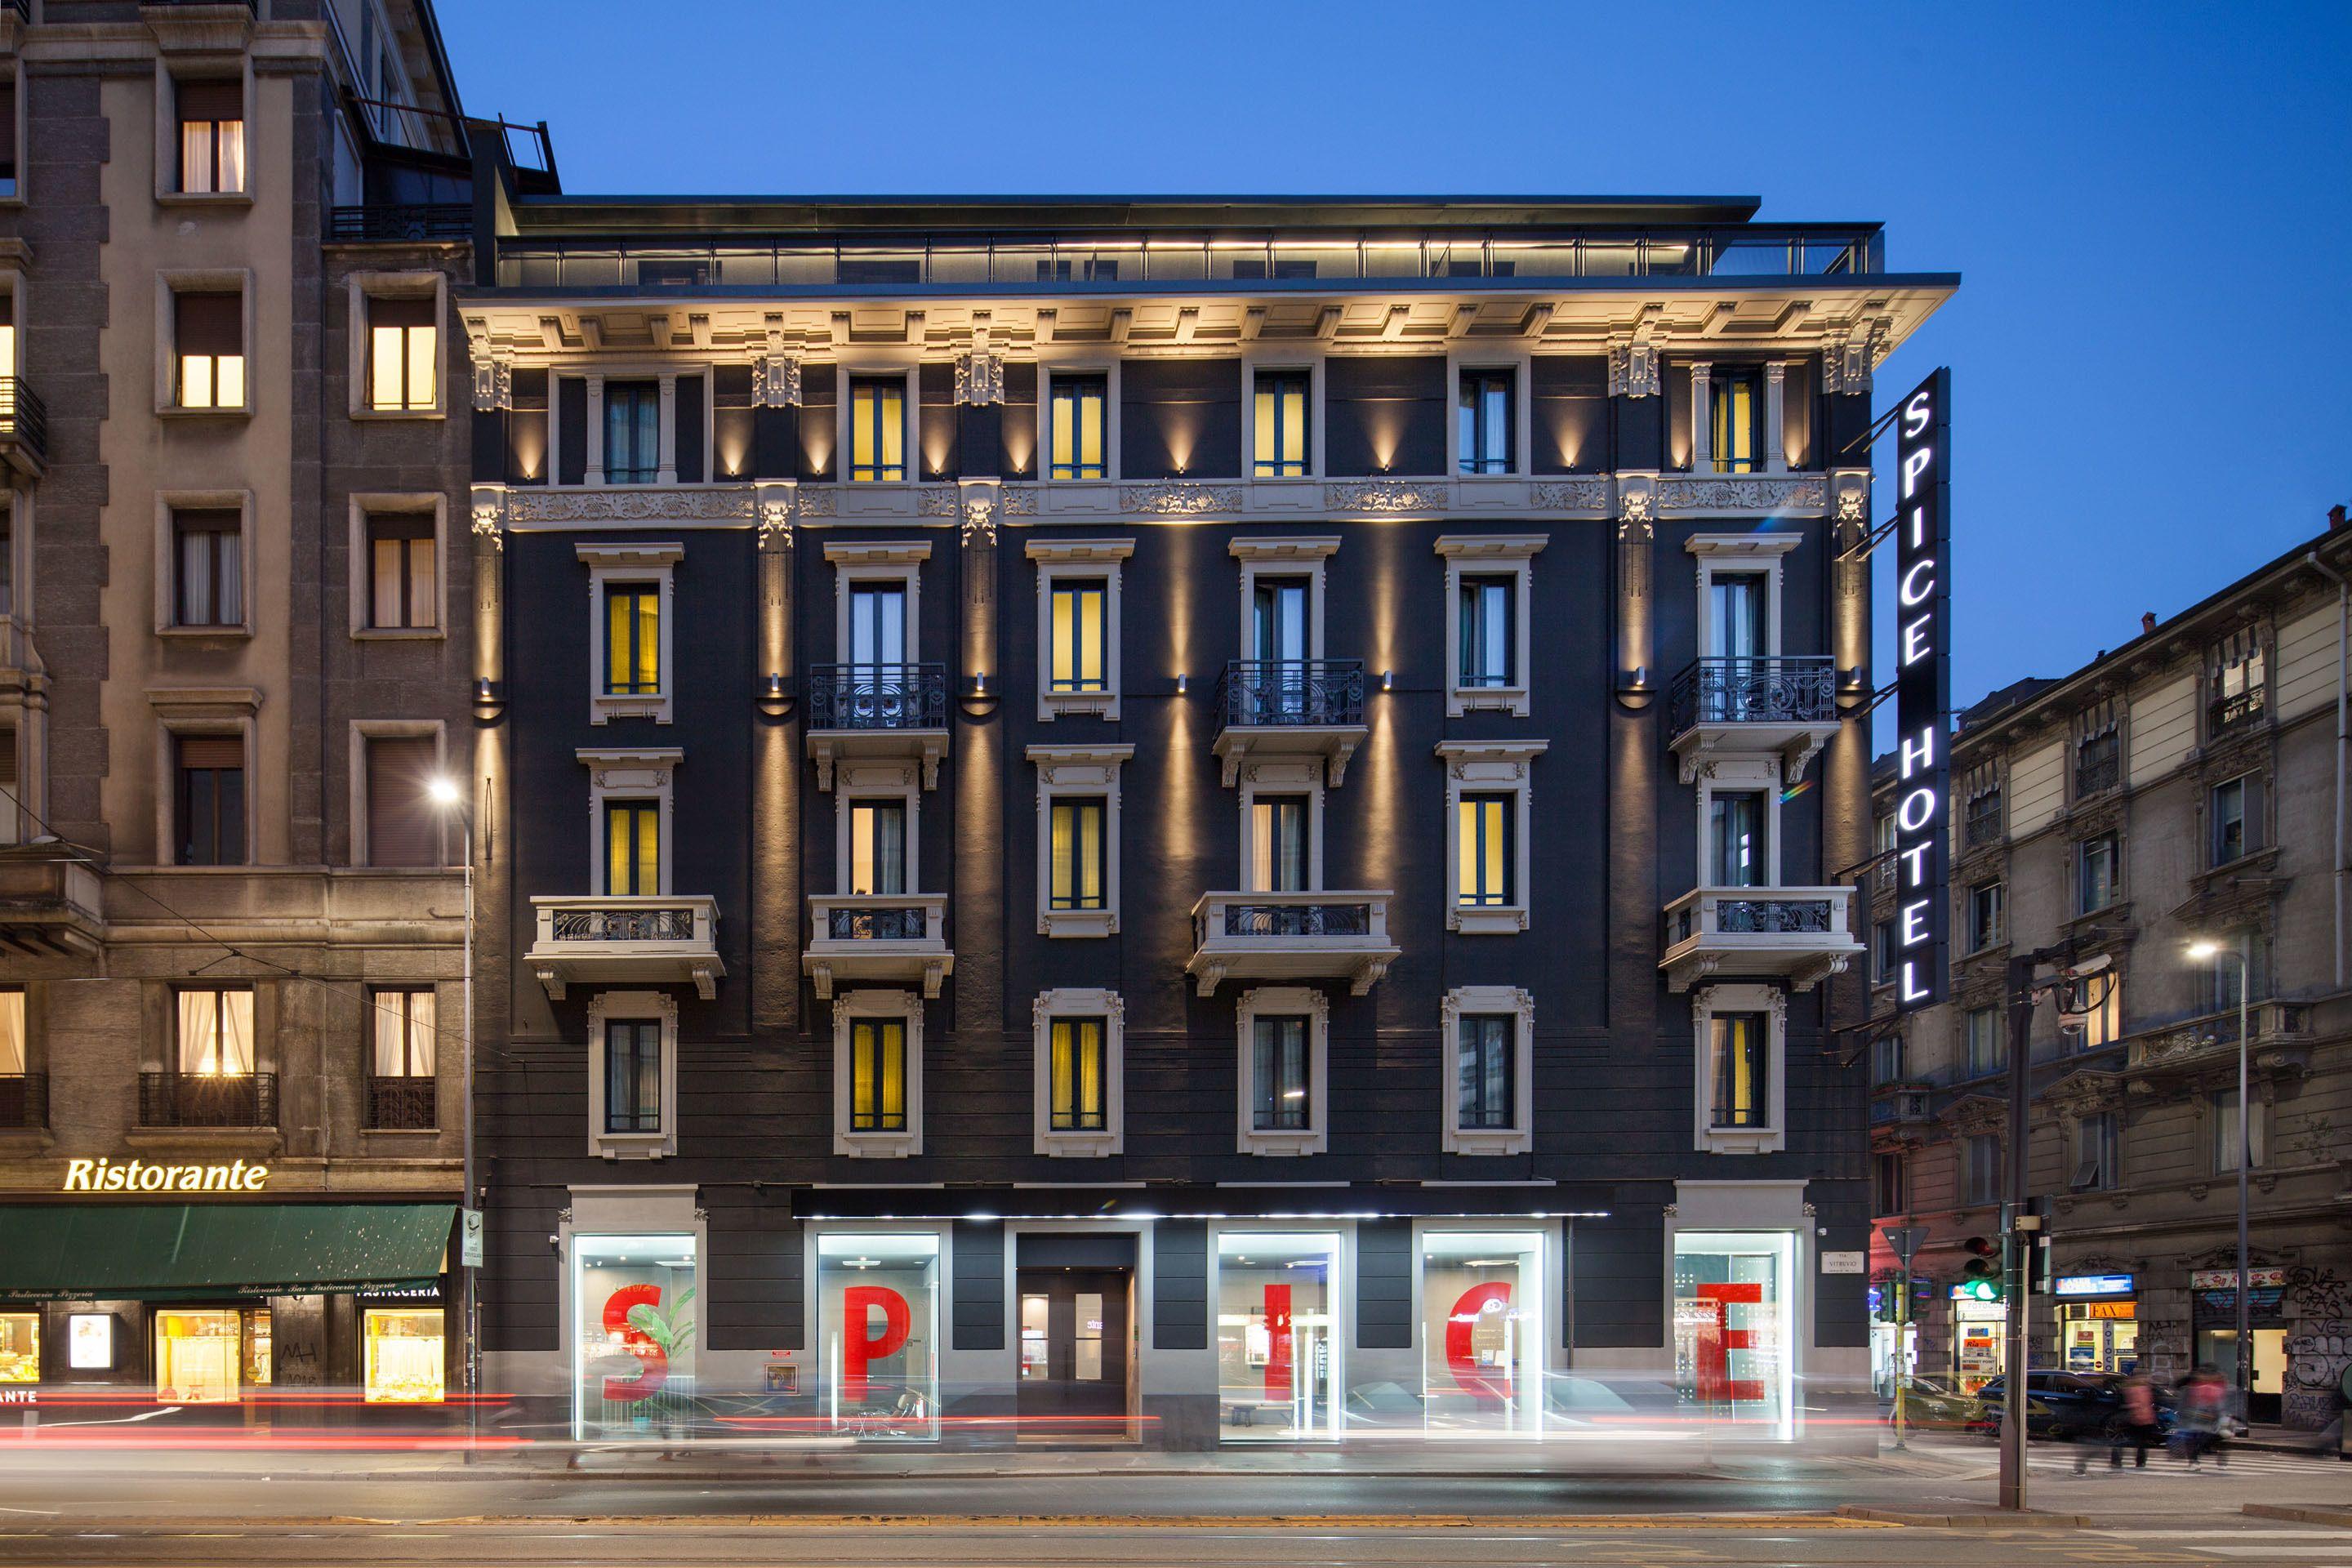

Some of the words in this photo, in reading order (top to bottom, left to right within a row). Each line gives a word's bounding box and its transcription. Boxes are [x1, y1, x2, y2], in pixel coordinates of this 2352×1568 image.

[1900, 391, 1935, 666] SPICE
[1899, 726, 1936, 1002] HOTEL
[63, 1158, 270, 1190] Ristorante
[7, 1290, 54, 1298] Pasticceria
[57, 1289, 94, 1300] Pizzeria
[238, 1285, 283, 1294] Ristorante
[287, 1284, 306, 1292] Bar
[311, 1282, 356, 1291] Pasticceria
[360, 1281, 397, 1292] Pizzeria
[2092, 1305, 2117, 1317] FAX
